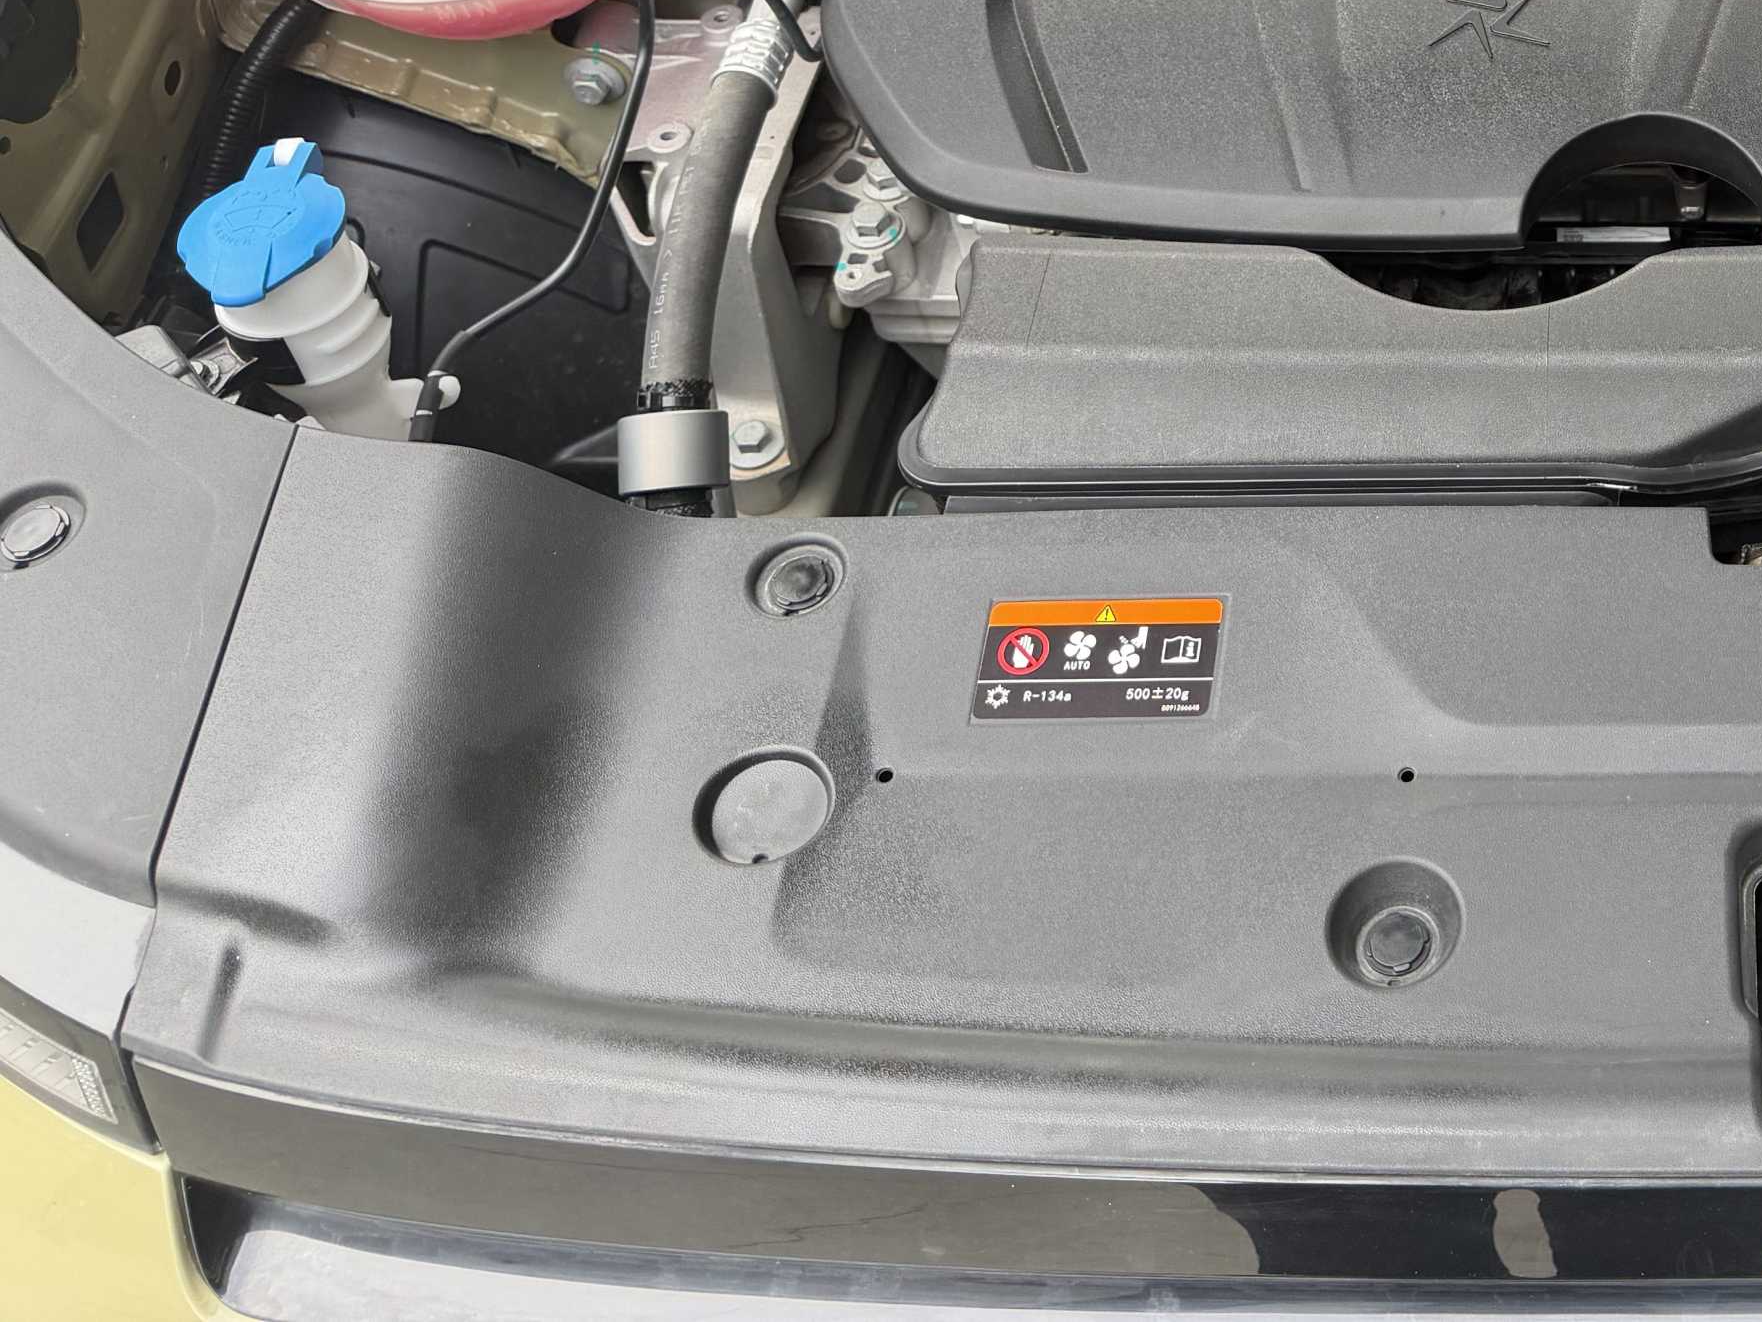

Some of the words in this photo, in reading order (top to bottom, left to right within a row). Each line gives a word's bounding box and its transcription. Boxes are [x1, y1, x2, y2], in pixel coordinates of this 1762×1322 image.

[431, 0, 498, 23] MIN
[1063, 660, 1091, 671] AUTO
[1023, 689, 1072, 703] R-134a
[1125, 687, 1190, 701] 500±20g
